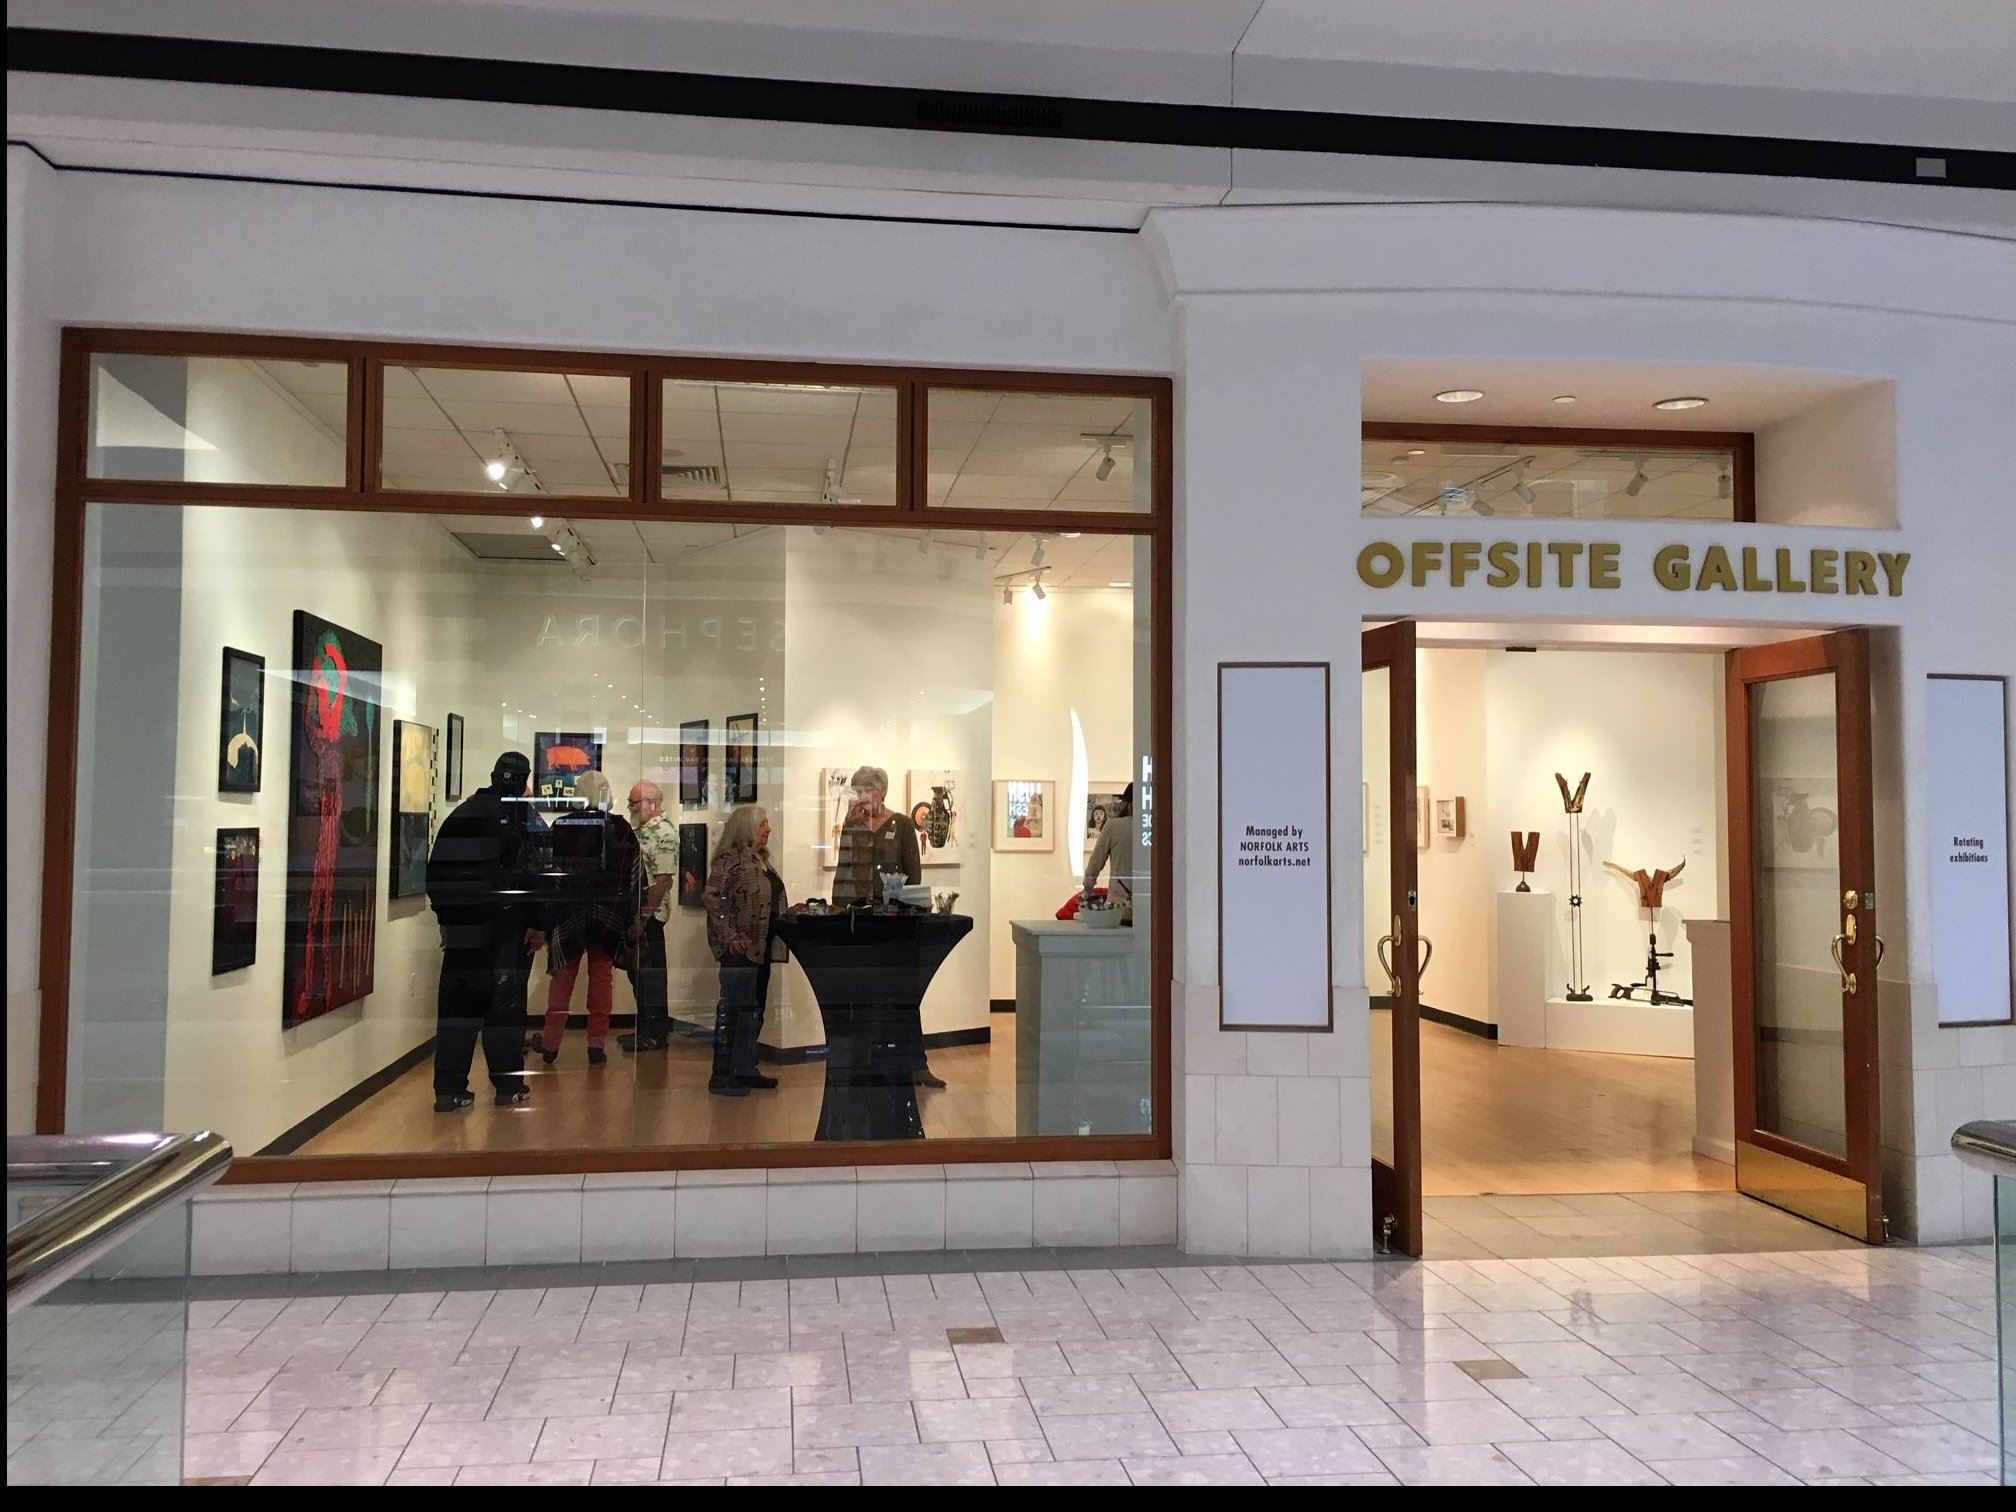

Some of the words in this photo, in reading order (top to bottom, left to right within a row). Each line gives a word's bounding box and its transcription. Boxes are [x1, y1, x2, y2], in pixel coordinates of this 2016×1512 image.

[1356, 541, 1621, 589] OFFSITE
[1653, 544, 1912, 597] GALLERY
[1245, 825, 1289, 839] Managed
[1291, 825, 1303, 839] by
[1240, 841, 1283, 852] NORFOLK
[1285, 841, 1309, 852] ARTS
[1953, 836, 1984, 849] Rotating
[1238, 855, 1311, 867] norfolkarts.net
[1949, 851, 1988, 862] exhibitions
